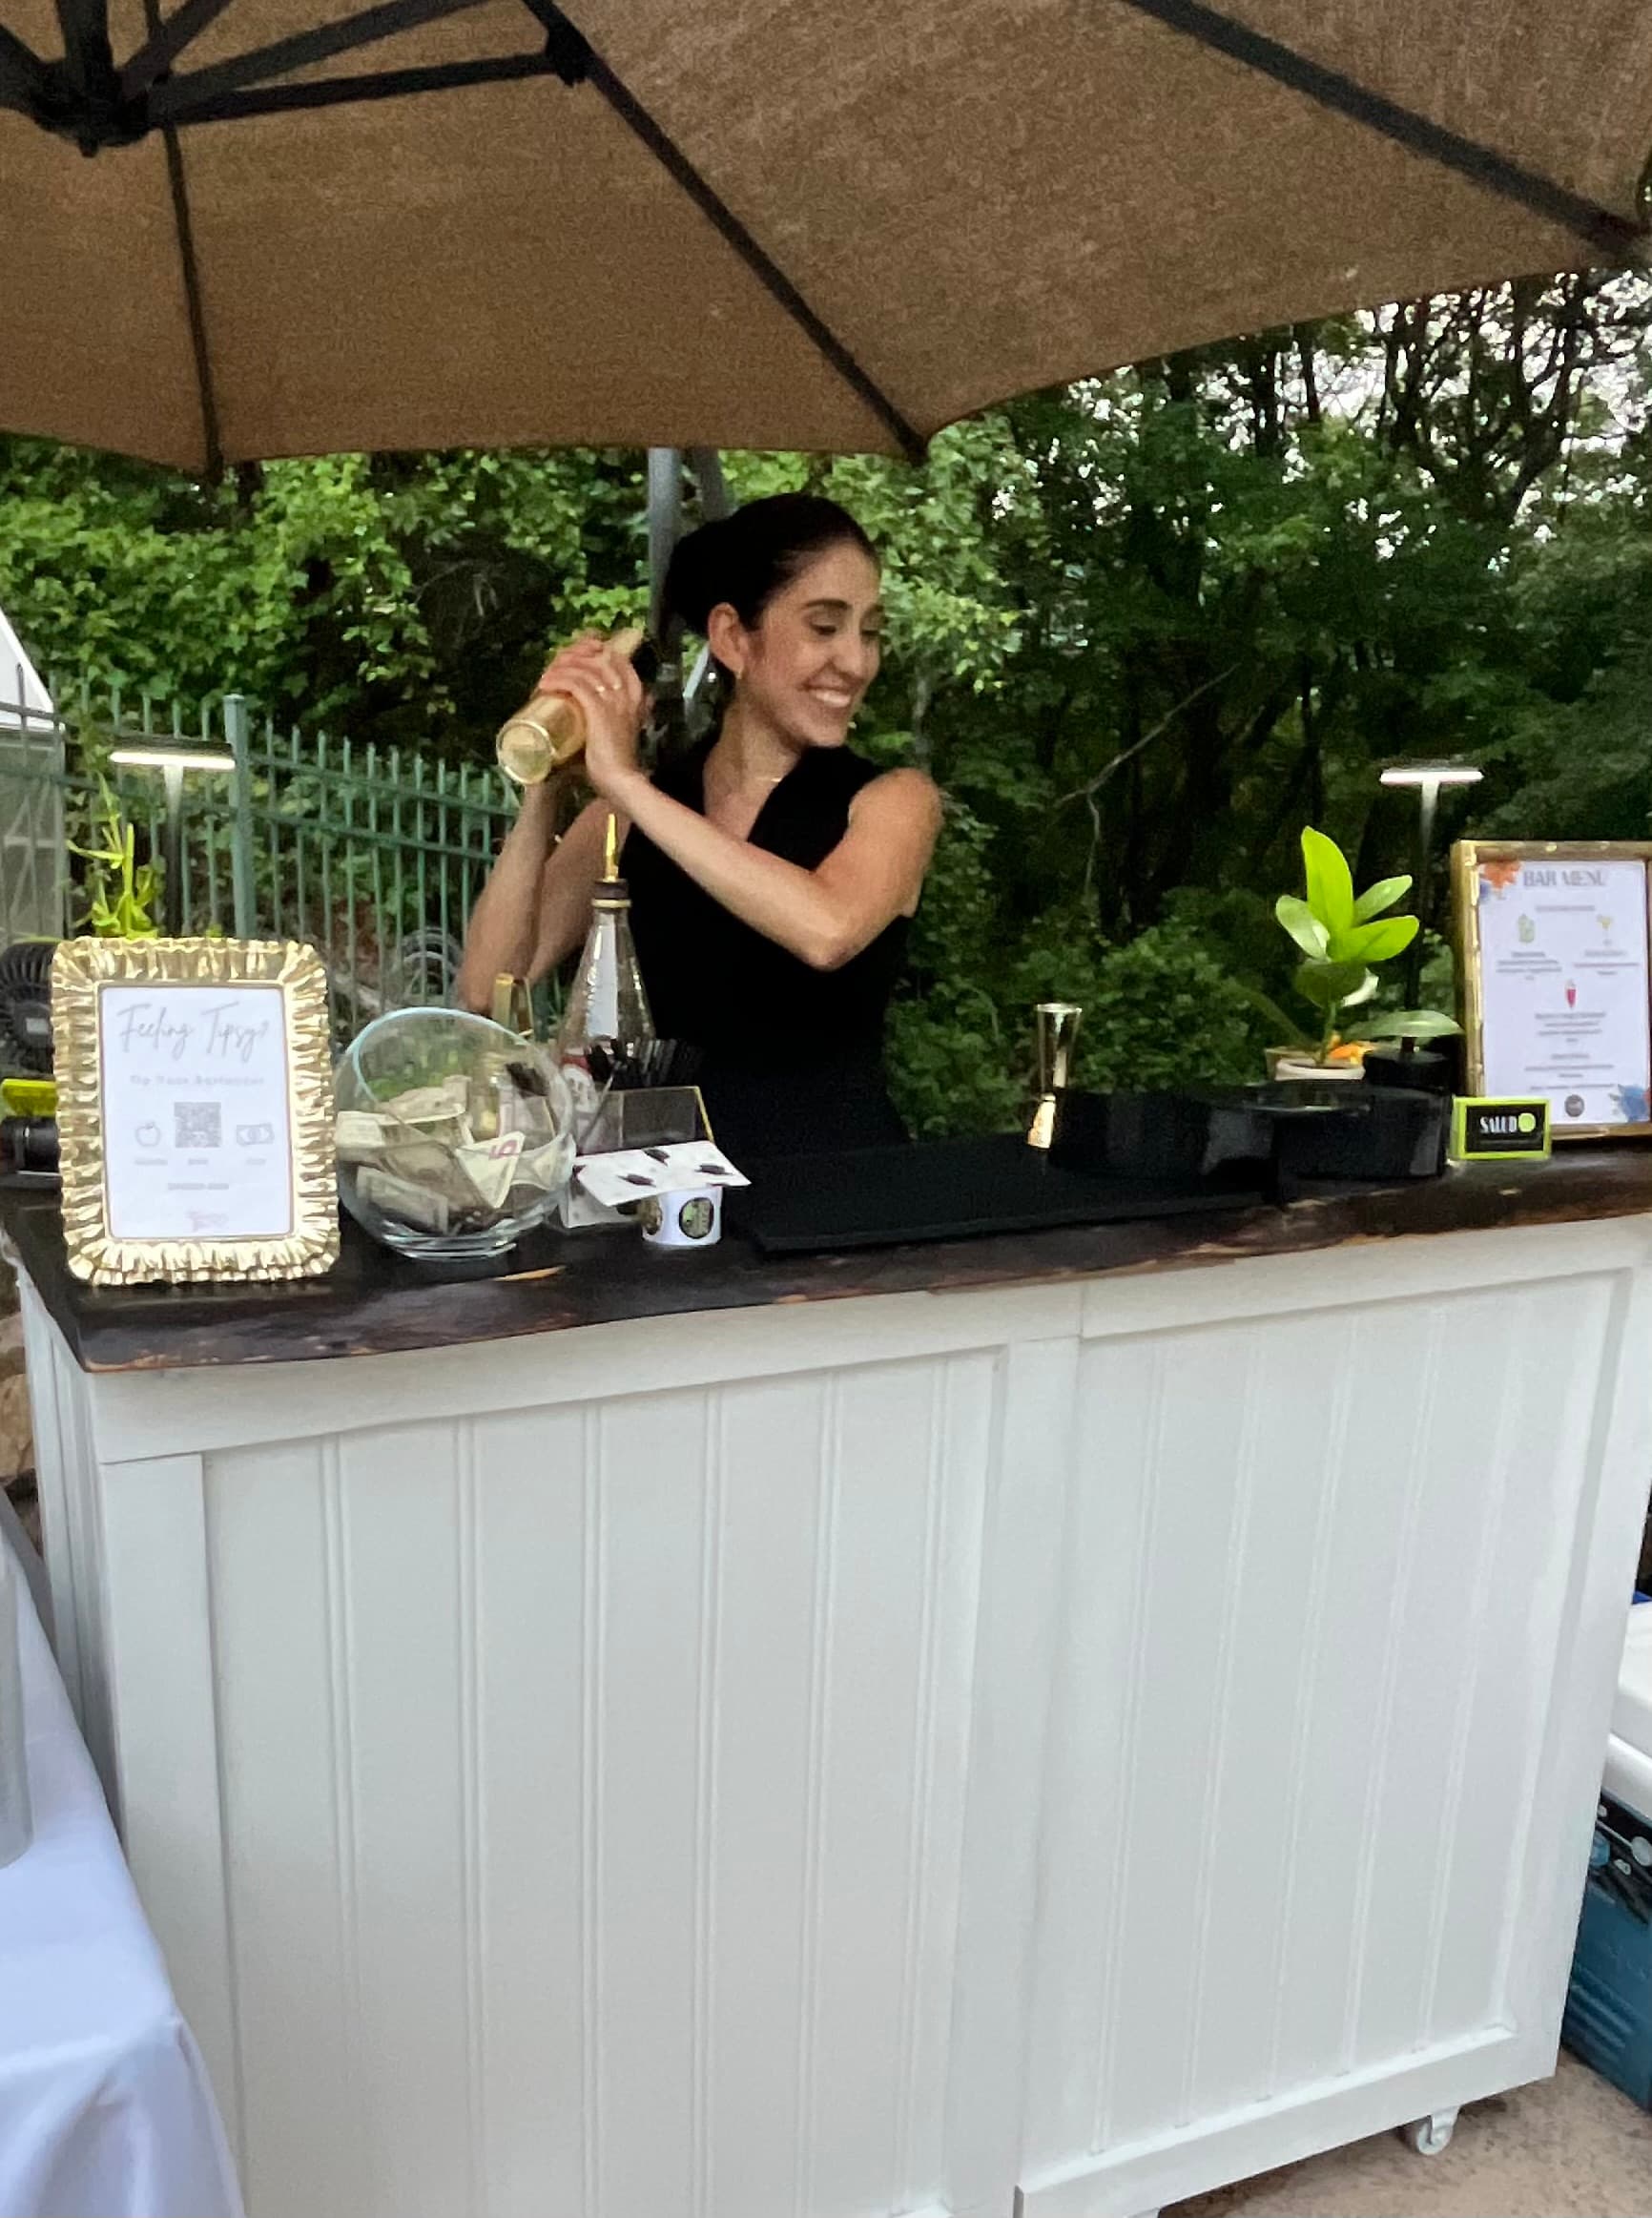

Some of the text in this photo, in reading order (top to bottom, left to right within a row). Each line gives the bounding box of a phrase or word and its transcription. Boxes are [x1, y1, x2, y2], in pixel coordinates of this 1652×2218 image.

[1523, 869, 1607, 887] BAR MENU
[116, 1003, 194, 1061] Feeling
